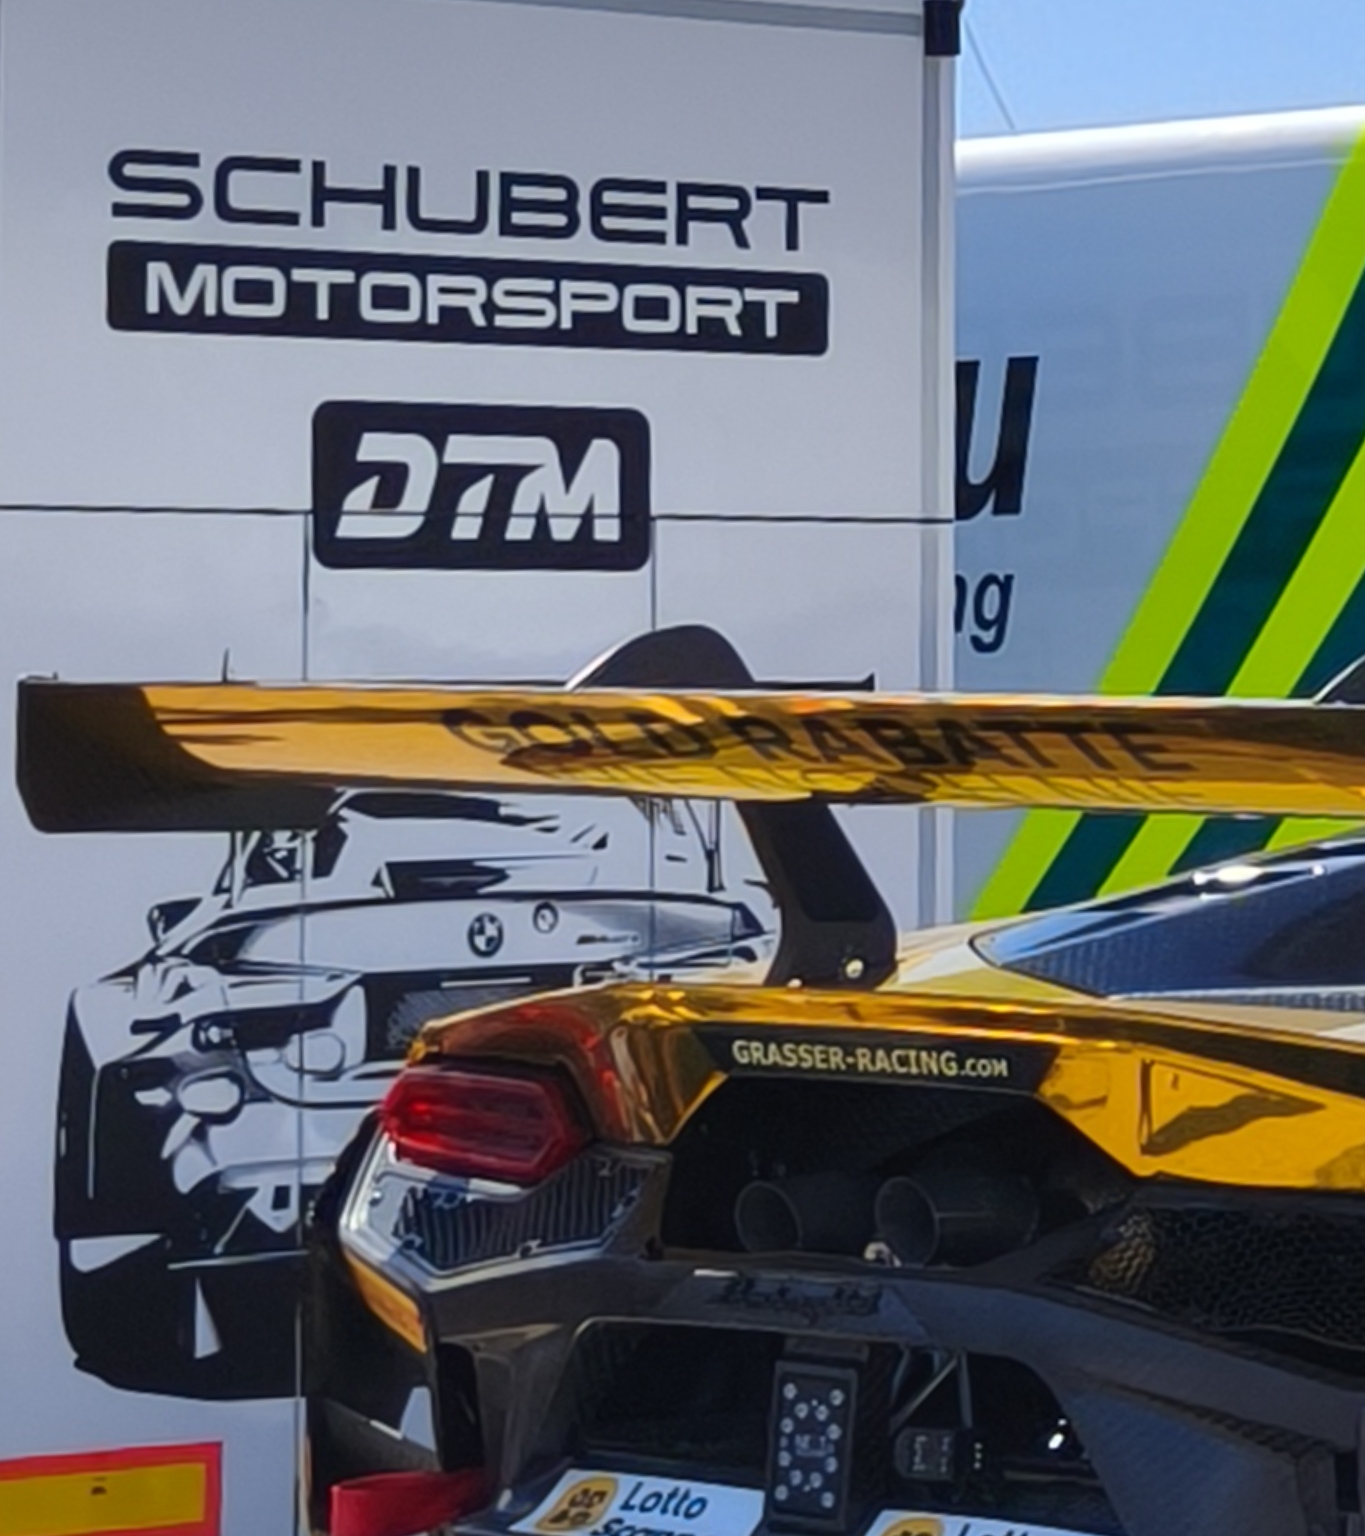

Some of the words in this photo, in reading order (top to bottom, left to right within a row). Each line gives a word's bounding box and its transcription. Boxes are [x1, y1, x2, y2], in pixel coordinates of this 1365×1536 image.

[108, 148, 830, 252] SCHUBERT
[145, 260, 800, 339] MOTORSPORT
[334, 431, 621, 542] DTM
[722, 713, 1200, 772] RABATTE
[619, 1481, 709, 1520] Lotto
